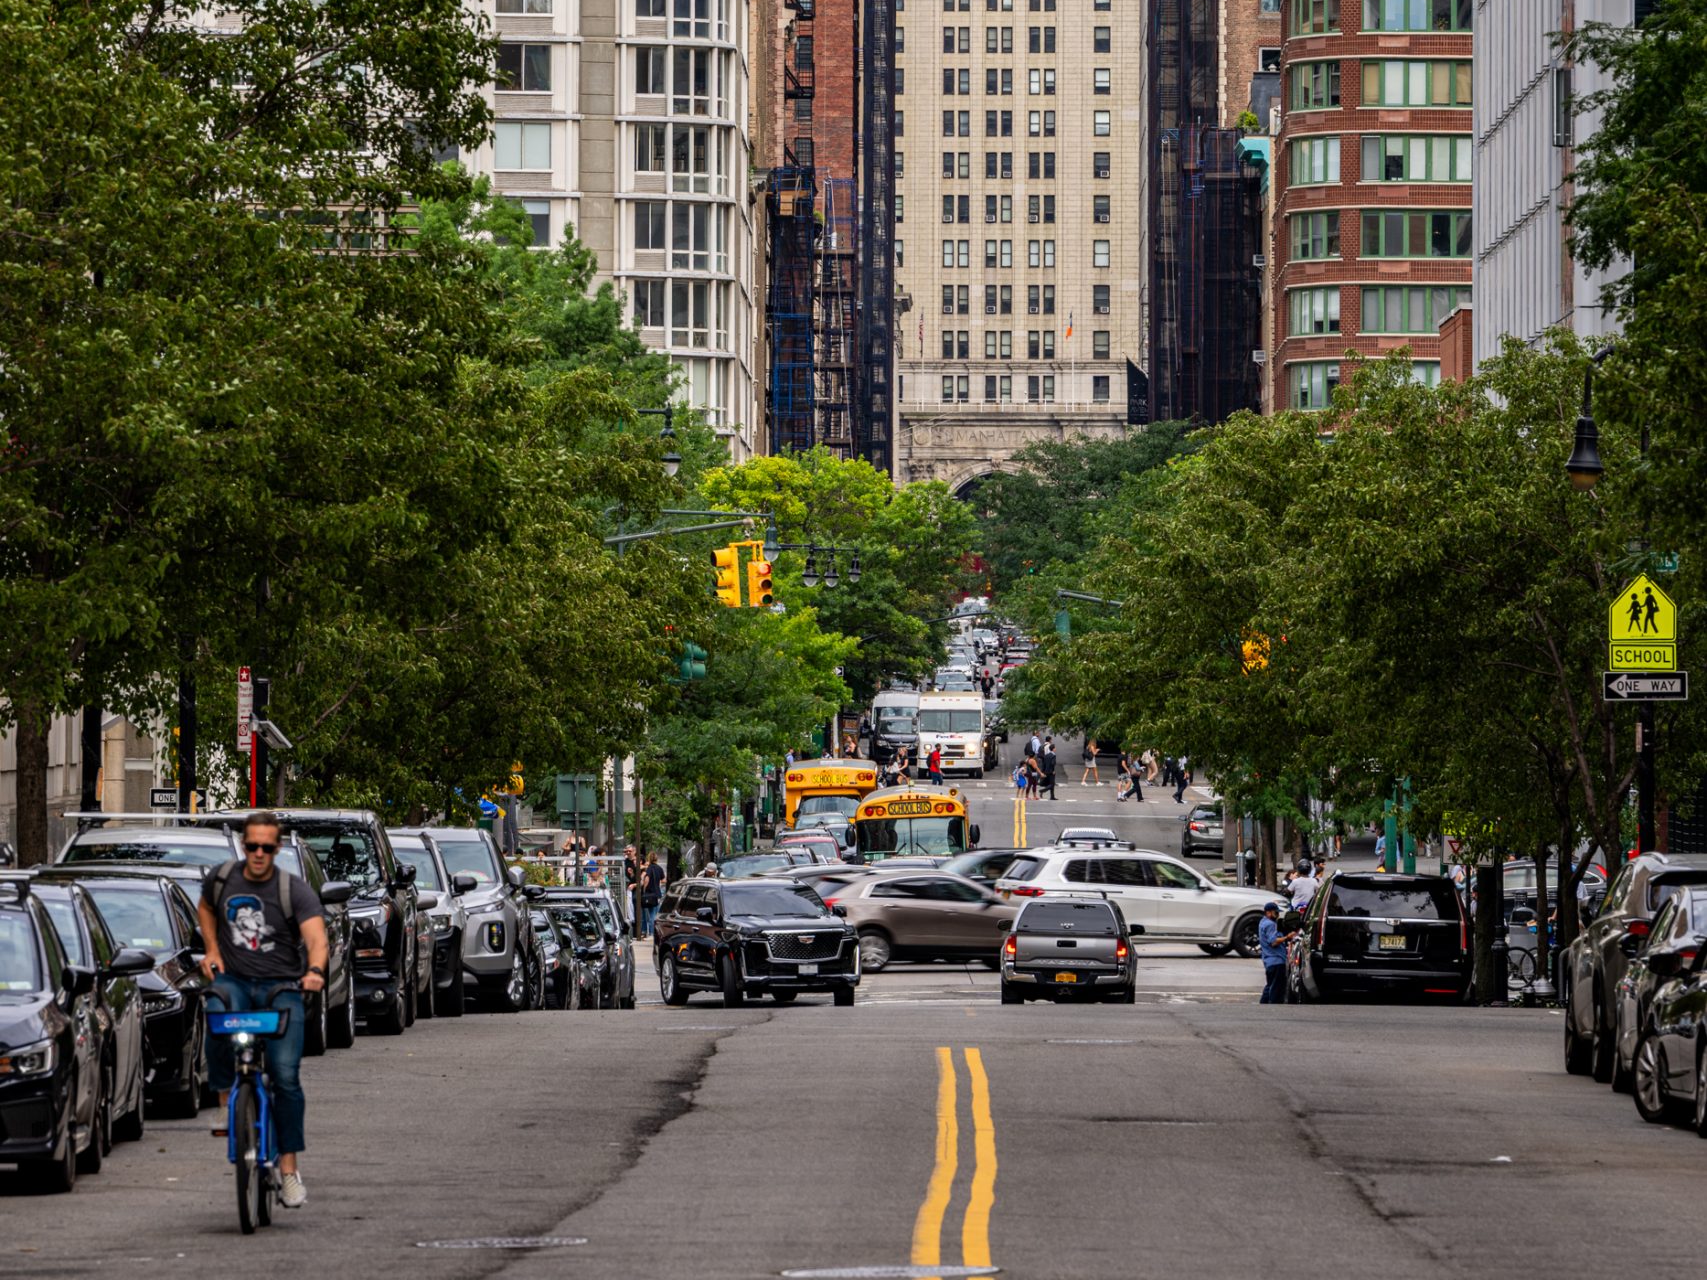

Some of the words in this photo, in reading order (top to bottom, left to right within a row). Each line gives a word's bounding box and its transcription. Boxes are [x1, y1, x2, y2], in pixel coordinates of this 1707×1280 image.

[956, 426, 1040, 442] MANHATTAN
[1614, 649, 1671, 663] SCHOOL
[1616, 680, 1640, 692] ONE
[1651, 680, 1677, 692] WAY
[811, 774, 834, 784] SCHOOL
[836, 774, 848, 784] BUS
[158, 794, 175, 802] ONE
[889, 803, 914, 815] SCHOOL
[916, 802, 930, 815] BUS
